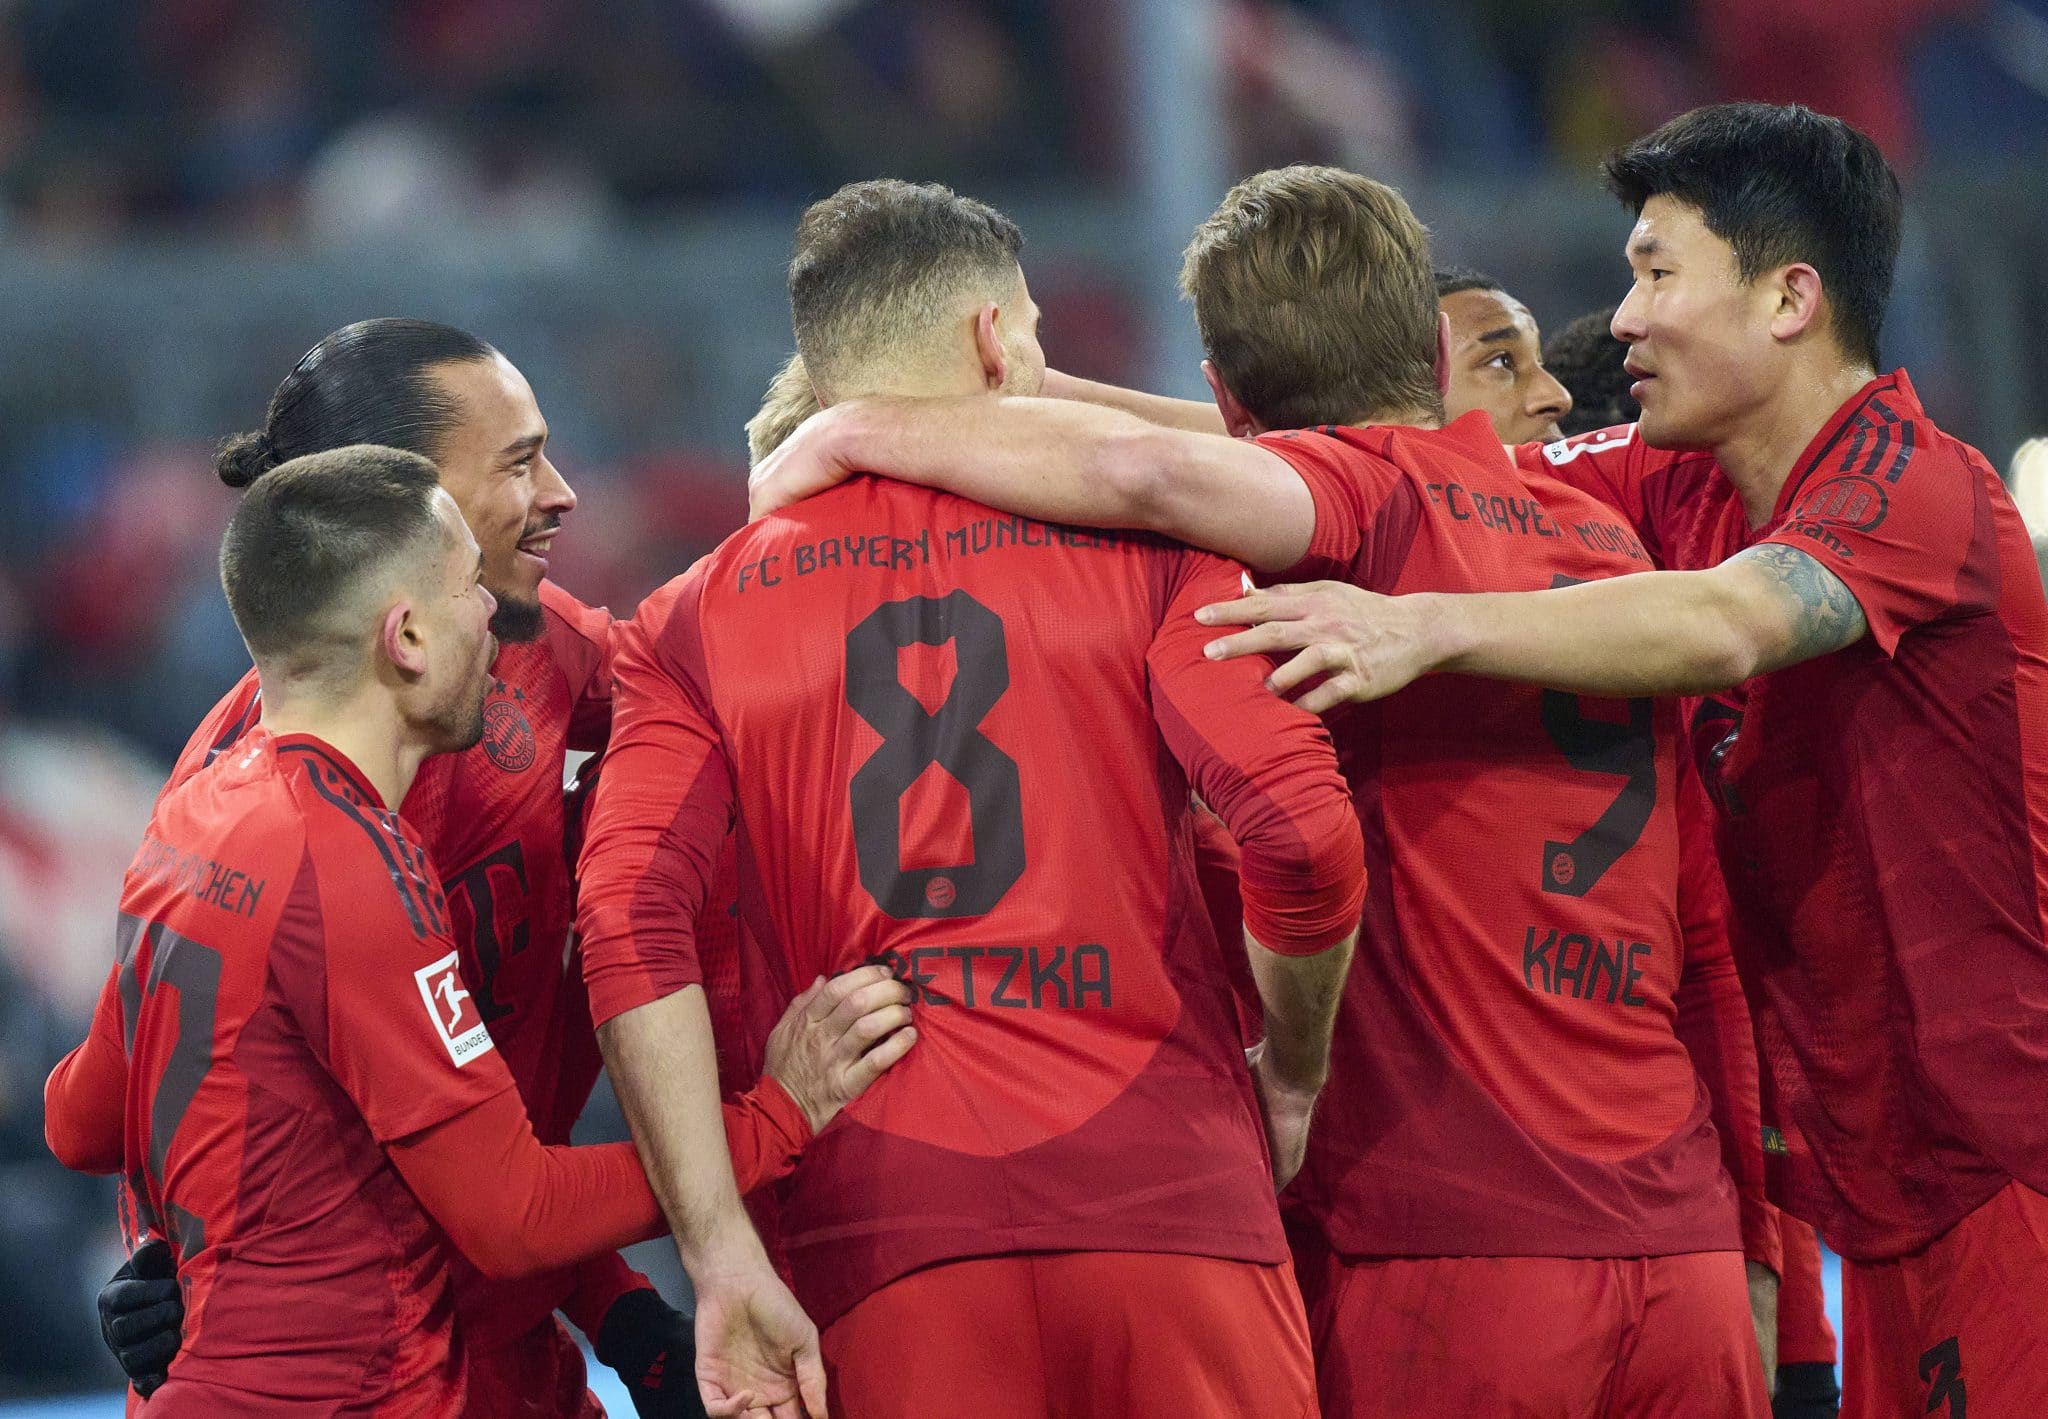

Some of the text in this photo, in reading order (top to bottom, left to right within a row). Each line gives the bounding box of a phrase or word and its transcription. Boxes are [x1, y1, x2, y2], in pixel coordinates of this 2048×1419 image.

[1471, 492, 1567, 538] BAYE
[738, 555, 781, 593] FC
[846, 588, 1027, 920] 8
[1540, 573, 1657, 897] 9
[1523, 926, 1652, 1006] KANE
[454, 1031, 489, 1056] BUNDES
